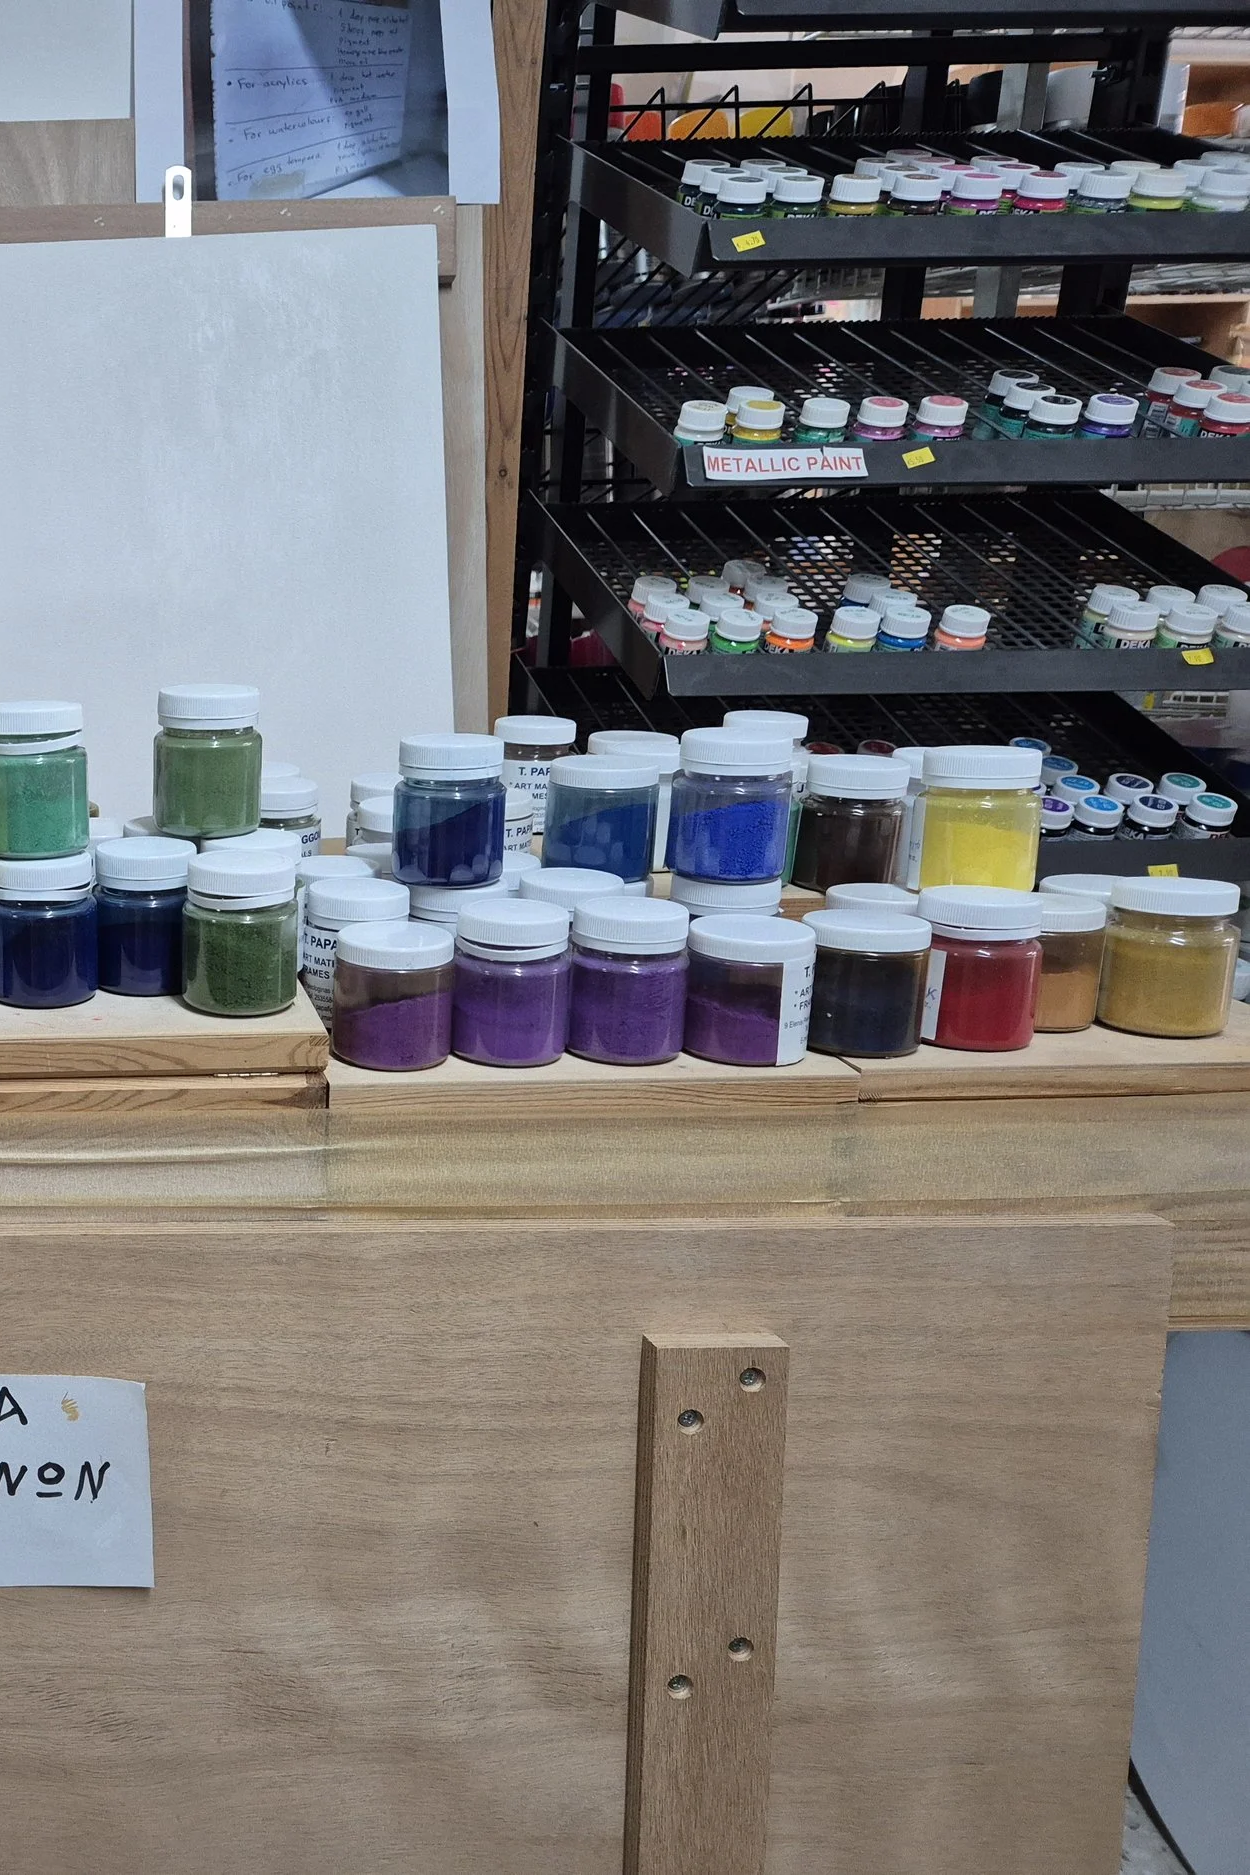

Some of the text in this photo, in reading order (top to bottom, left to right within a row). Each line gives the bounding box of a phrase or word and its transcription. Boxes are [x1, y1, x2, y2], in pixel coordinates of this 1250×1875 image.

[237, 77, 255, 90] For
[707, 455, 863, 474] METALLIC PAINT
[1120, 640, 1150, 649] DEKA
[514, 782, 531, 790] ART
